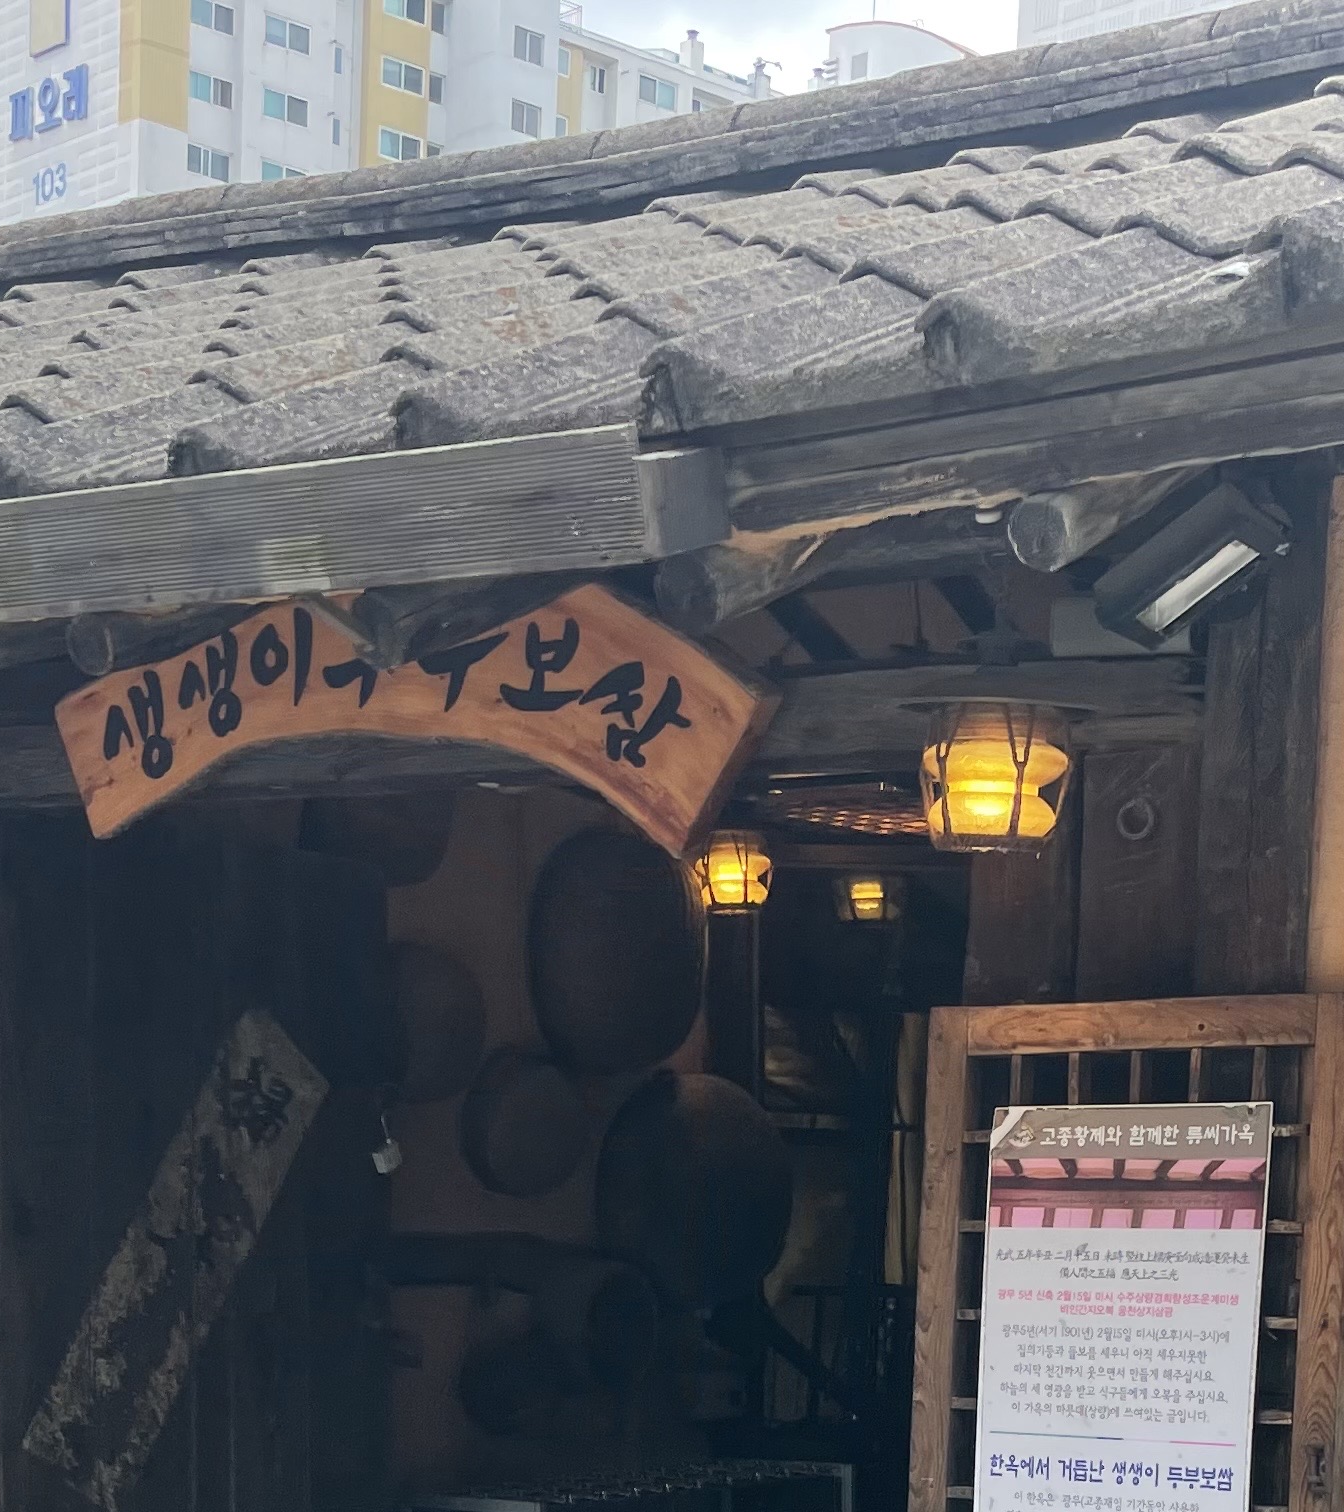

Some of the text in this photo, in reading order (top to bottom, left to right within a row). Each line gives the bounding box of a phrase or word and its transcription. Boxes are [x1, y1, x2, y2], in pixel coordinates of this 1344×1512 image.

[9, 63, 89, 141] 피오레
[33, 162, 67, 205] 103
[1039, 1123, 1256, 1147] 고종황제와 함께한 류씨가옥
[1133, 1347, 1153, 1361] 아직
[1014, 1363, 1041, 1377] 마지막
[1000, 1382, 1027, 1396] 하늘의
[1044, 1384, 1072, 1398] 영광을
[1076, 1385, 1095, 1399] 받고
[1011, 1402, 1020, 1413] 이
[1024, 1402, 1052, 1416] 가옥의
[990, 1453, 1234, 1491] 한옥에서 거듭난 생생이 두부보쌈
